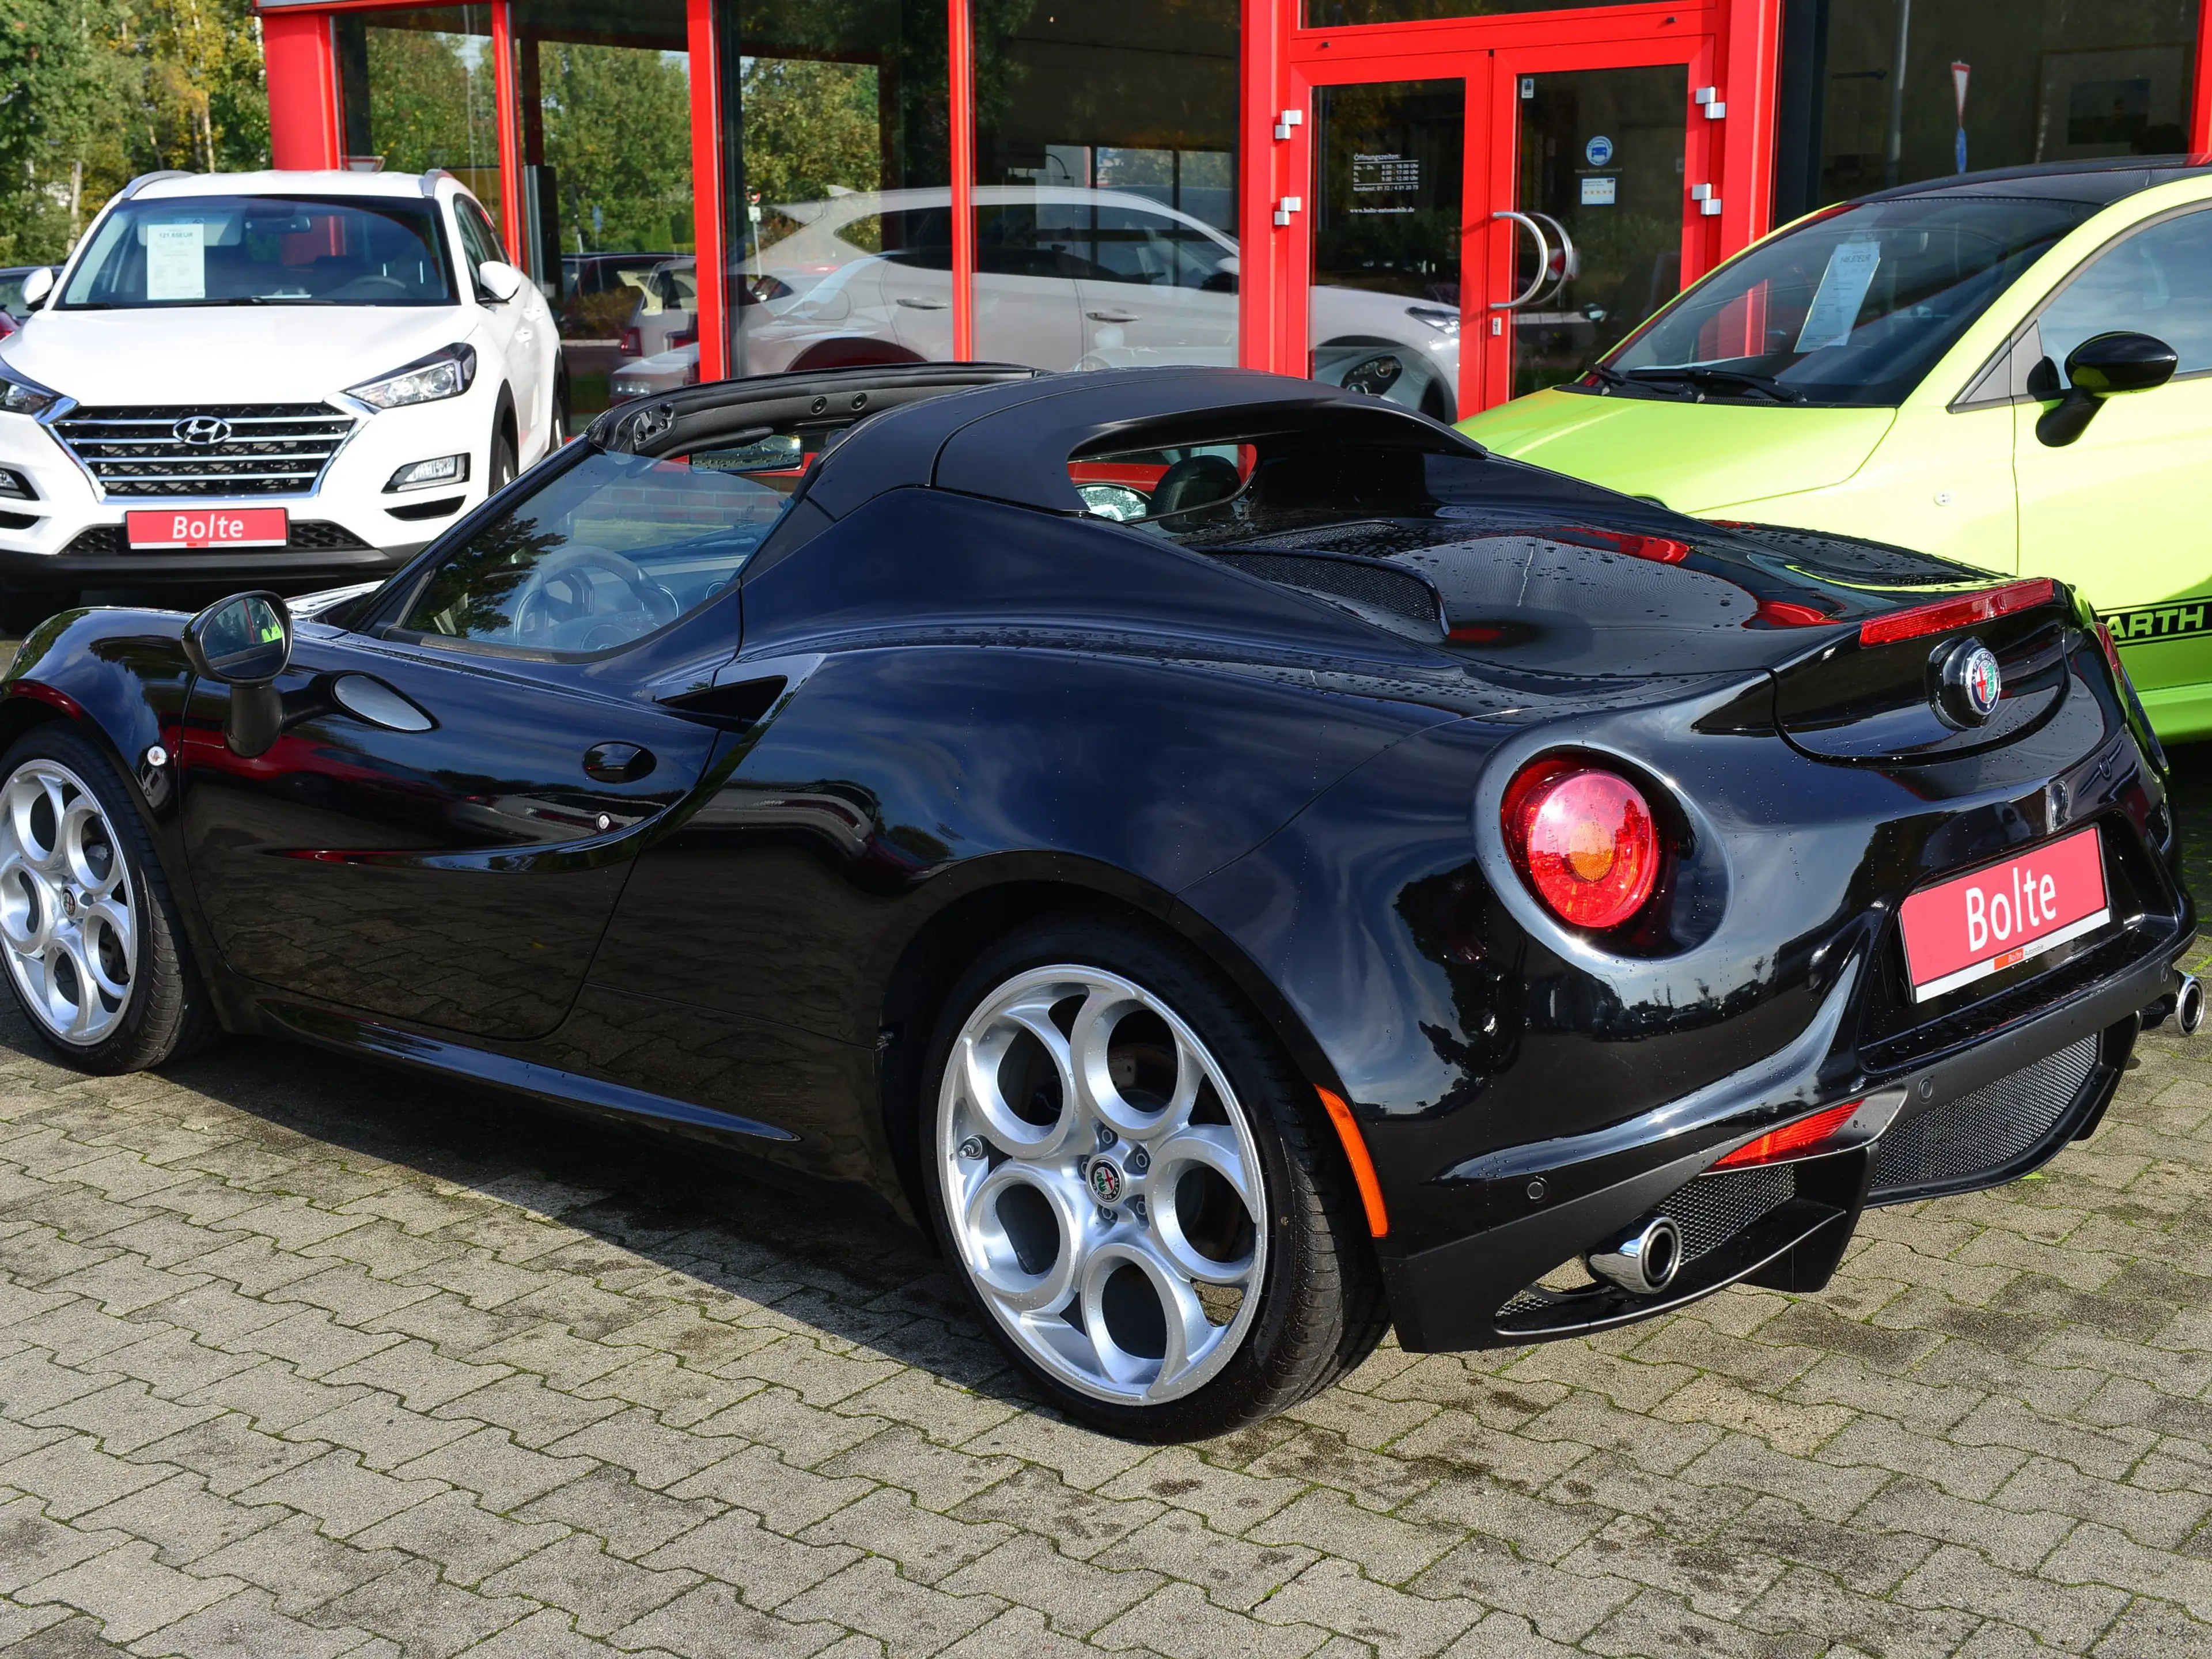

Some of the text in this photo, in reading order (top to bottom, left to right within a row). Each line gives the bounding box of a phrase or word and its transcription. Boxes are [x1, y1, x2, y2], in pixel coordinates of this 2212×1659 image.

[1353, 153, 1401, 162] Öffnungszeiten:
[173, 513, 244, 539] Bolte
[1965, 867, 2056, 952] Bolte
[2008, 952, 2022, 963] Bolte
